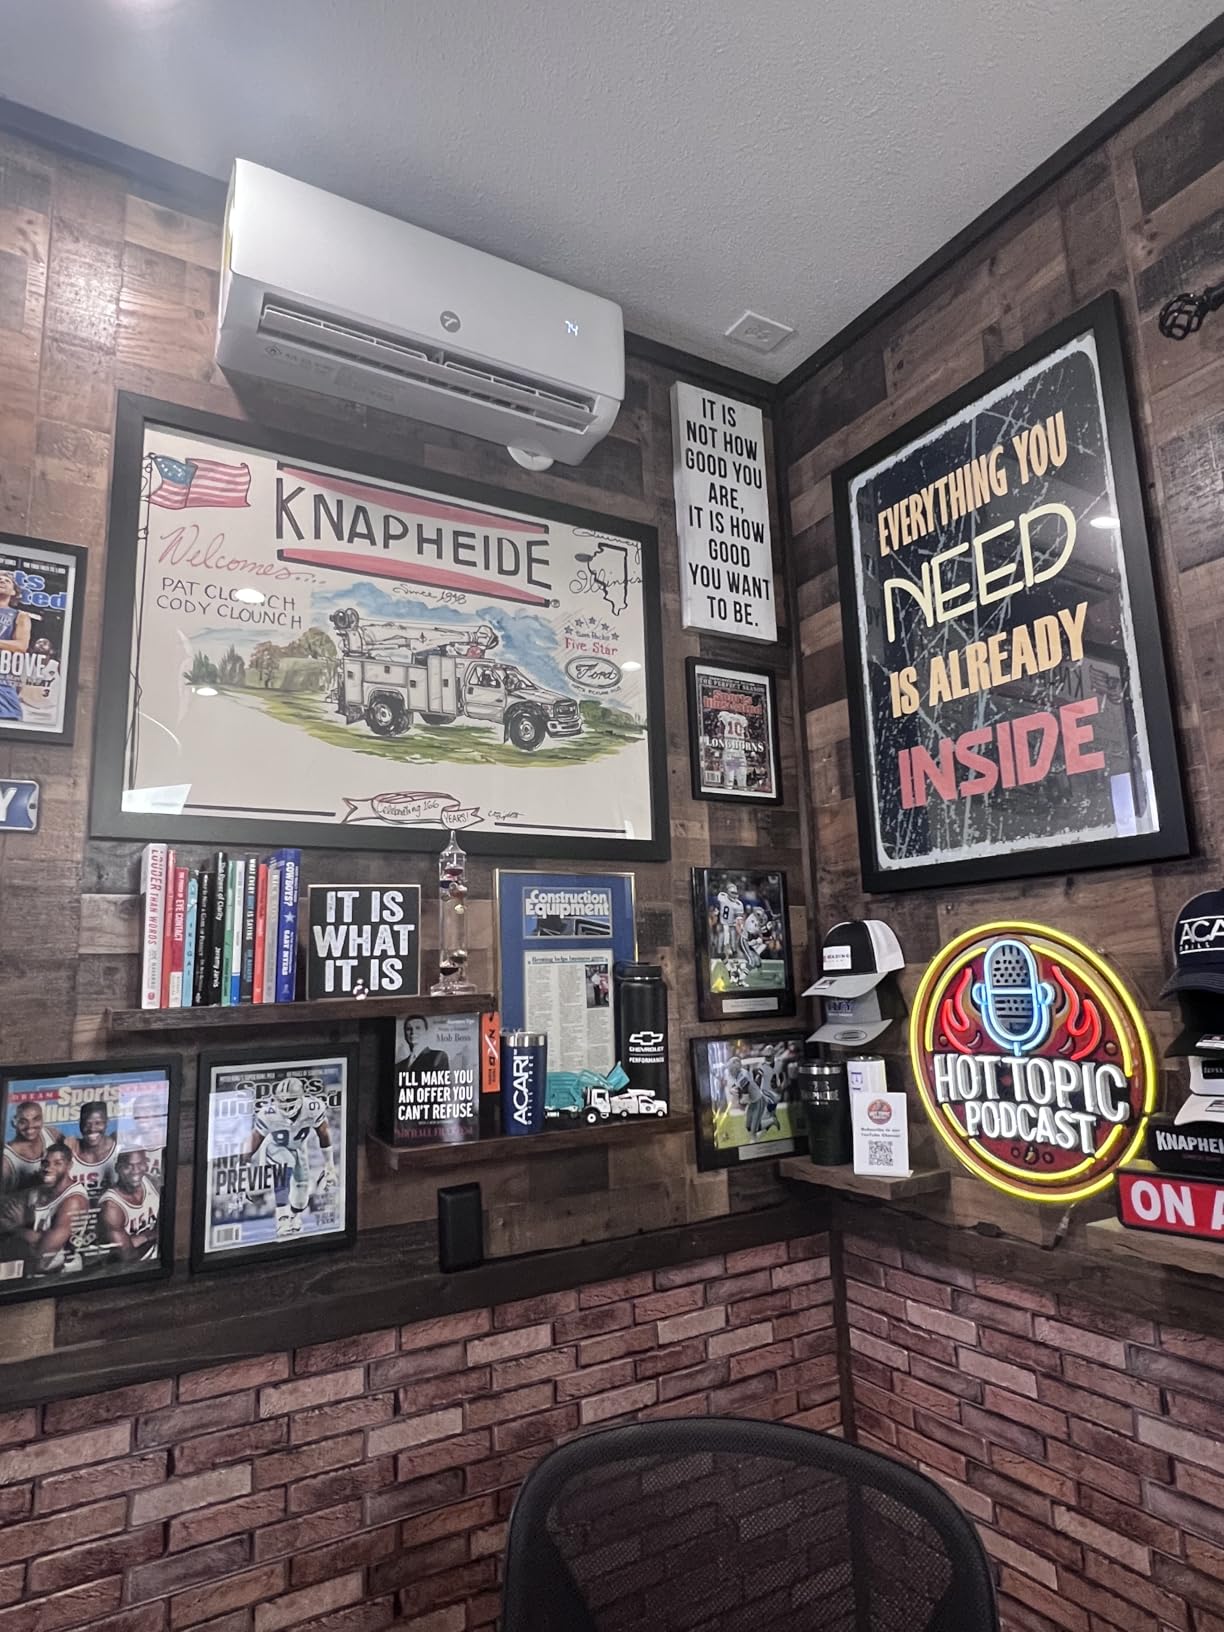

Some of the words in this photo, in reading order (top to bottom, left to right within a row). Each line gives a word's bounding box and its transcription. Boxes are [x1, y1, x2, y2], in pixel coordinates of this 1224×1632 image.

[702, 398, 716, 421] IT
[722, 404, 737, 428] IS
[686, 420, 718, 448] NOT
[724, 432, 757, 462] HOW
[685, 448, 727, 479] GOOD
[732, 462, 762, 489] YOU
[878, 444, 1007, 557] EVERYTHING
[1012, 410, 1068, 485] YOU
[276, 477, 552, 590] KNAPHEIDE
[689, 505, 703, 529] IT
[710, 510, 724, 534] IS
[730, 515, 765, 545] HOW
[708, 538, 750, 568] GOOD
[689, 562, 721, 590] YOU
[726, 570, 770, 601] WANT
[883, 502, 1077, 643] NEED
[162, 577, 200, 597] PAT
[204, 584, 295, 611] CLOCH
[707, 595, 727, 621] TO
[156, 595, 212, 615] CODY
[217, 604, 302, 629] CLOUNCH
[565, 637, 587, 652] Five
[592, 641, 618, 655] Star
[890, 666, 920, 720] IS
[928, 602, 1089, 707] ALREADY
[575, 662, 618, 680] Ford
[898, 697, 1105, 810] INSIDE
[150, 849, 164, 891] LOUDER
[284, 862, 295, 906] COWBOYS?
[149, 892, 158, 914] THAN
[175, 899, 184, 911] EYE
[215, 901, 224, 921] Clarity
[217, 893, 225, 901] of
[326, 891, 360, 923] IT
[371, 890, 404, 923] IS
[525, 898, 609, 919] Equipment
[530, 889, 607, 904] Construction
[147, 916, 158, 945] WORDS
[174, 912, 183, 942] CONTACT
[282, 929, 290, 948] GARY
[312, 924, 416, 958] WHAT
[213, 946, 221, 969] Jeremy
[324, 959, 358, 992] IT
[369, 958, 403, 991] IS
[398, 1071, 419, 1087] I'LL
[421, 1070, 451, 1086] MAKE
[453, 1069, 473, 1084] YOU
[398, 1087, 415, 1104] AN
[416, 1086, 451, 1103] OFFER
[452, 1085, 473, 1101] YOU
[513, 1055, 529, 1125] ACARI
[933, 1053, 1001, 1103] HOT
[1001, 1056, 1131, 1123] TOPIC
[58, 1085, 120, 1106] Sports
[398, 1104, 430, 1120] CAN'T
[432, 1102, 474, 1120] REFUSE
[964, 1100, 1097, 1155] PODCAST
[1155, 1129, 1224, 1154] KNAPHEI
[215, 1162, 288, 1196] PREVIEW
[1130, 1179, 1196, 1227] ON
